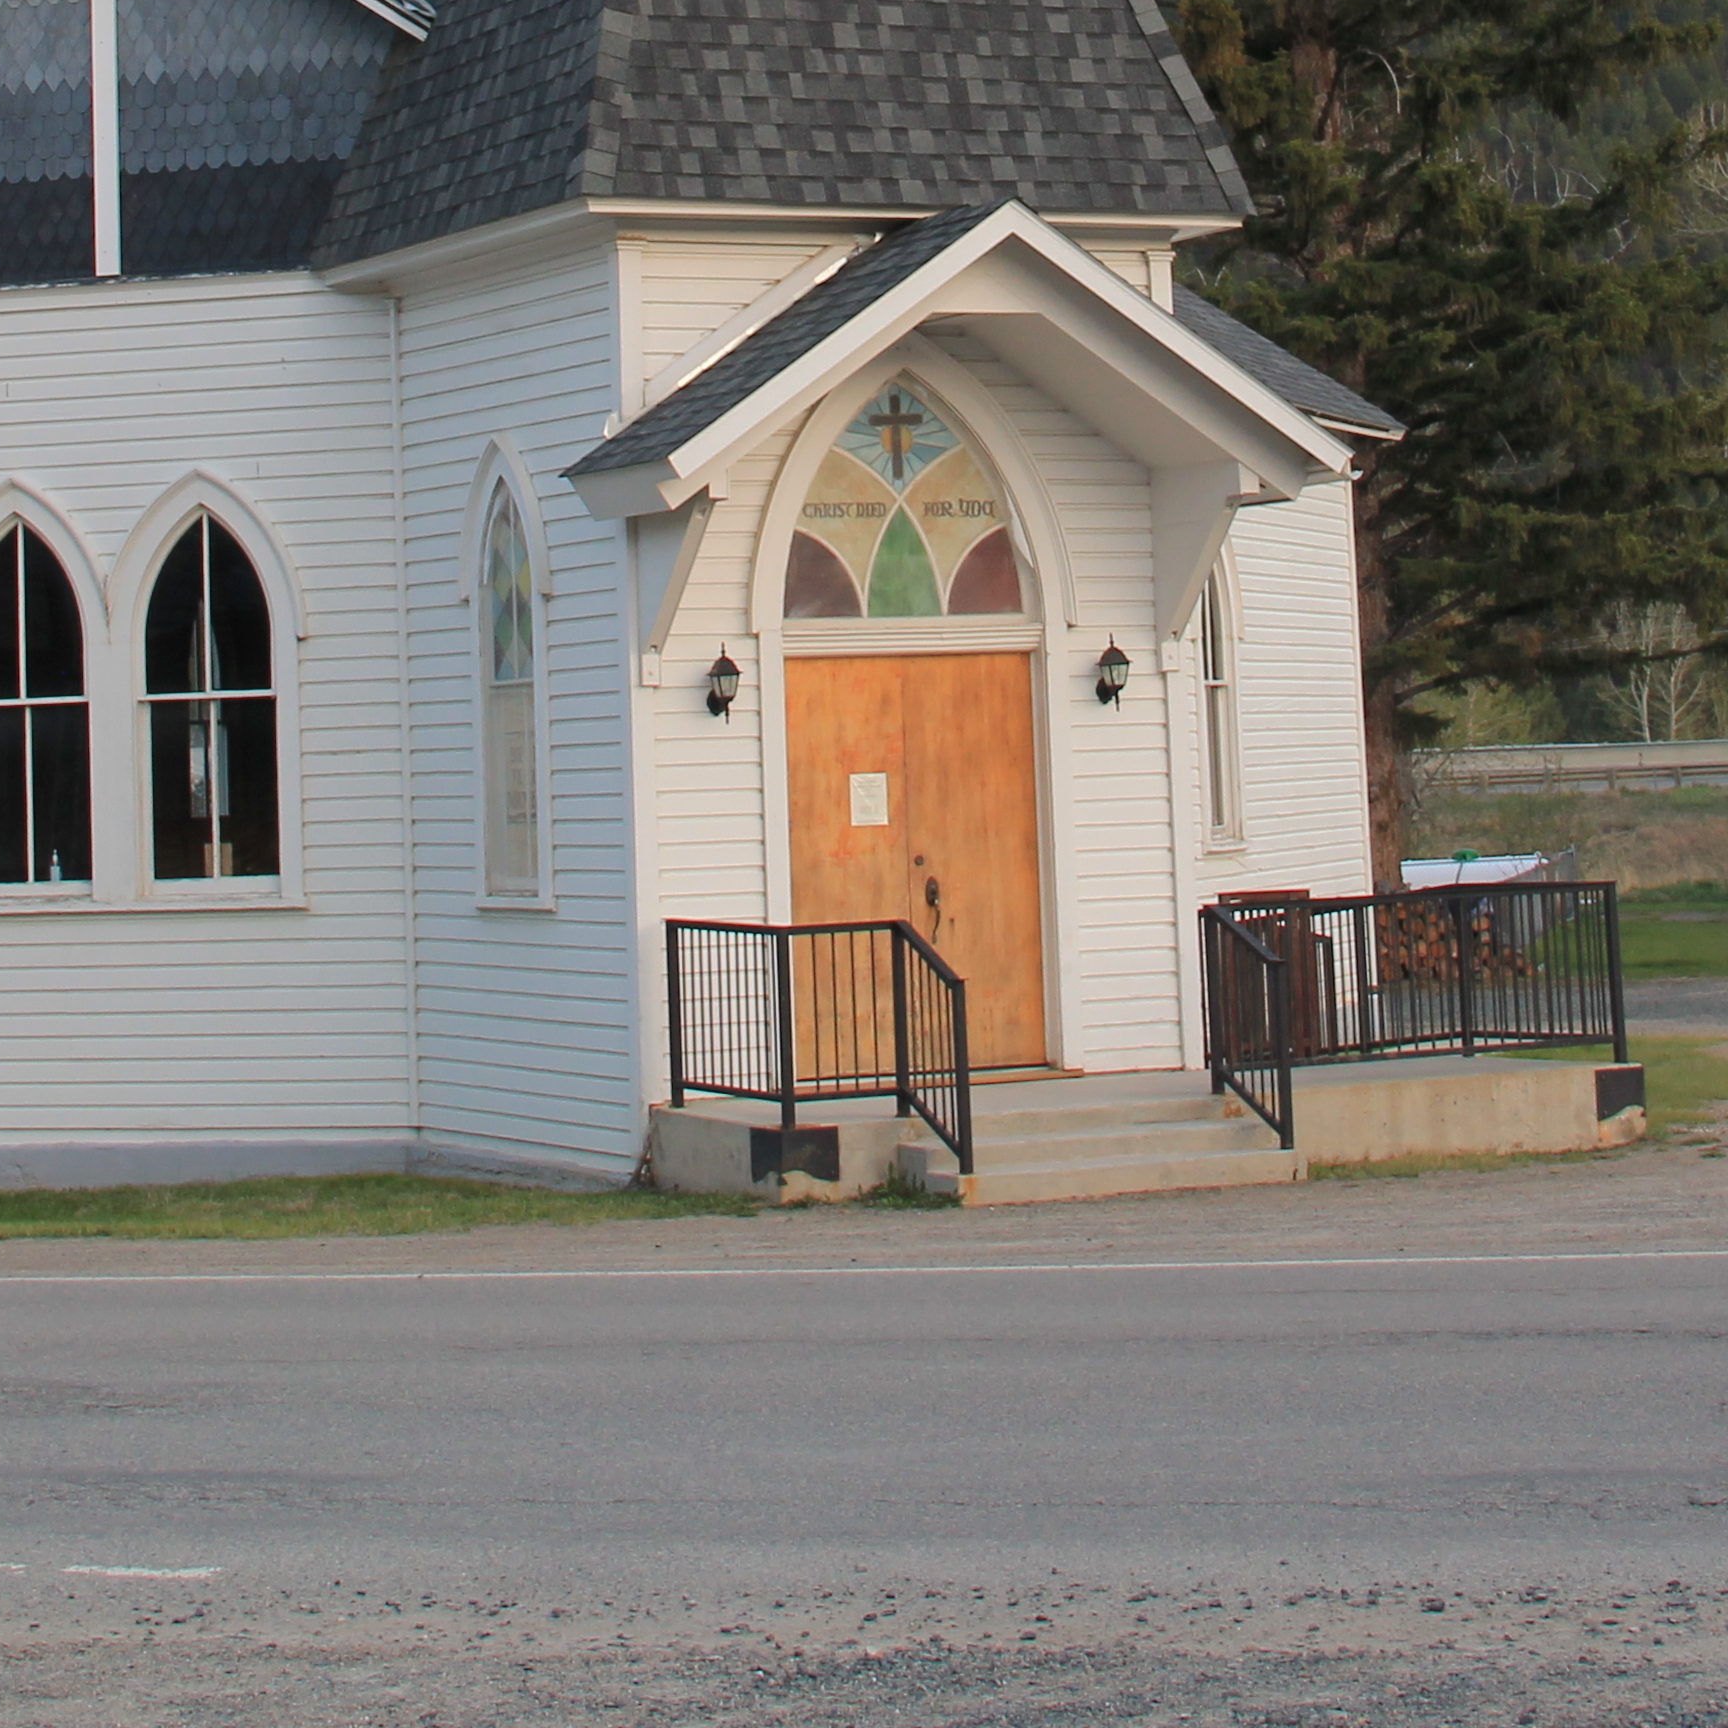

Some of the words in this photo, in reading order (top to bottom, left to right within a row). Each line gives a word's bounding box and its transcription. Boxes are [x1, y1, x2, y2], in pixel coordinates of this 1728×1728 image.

[802, 502, 854, 519] CHRIST
[856, 501, 887, 518] DIED
[923, 500, 956, 518] FOR
[958, 498, 997, 519] YOU
